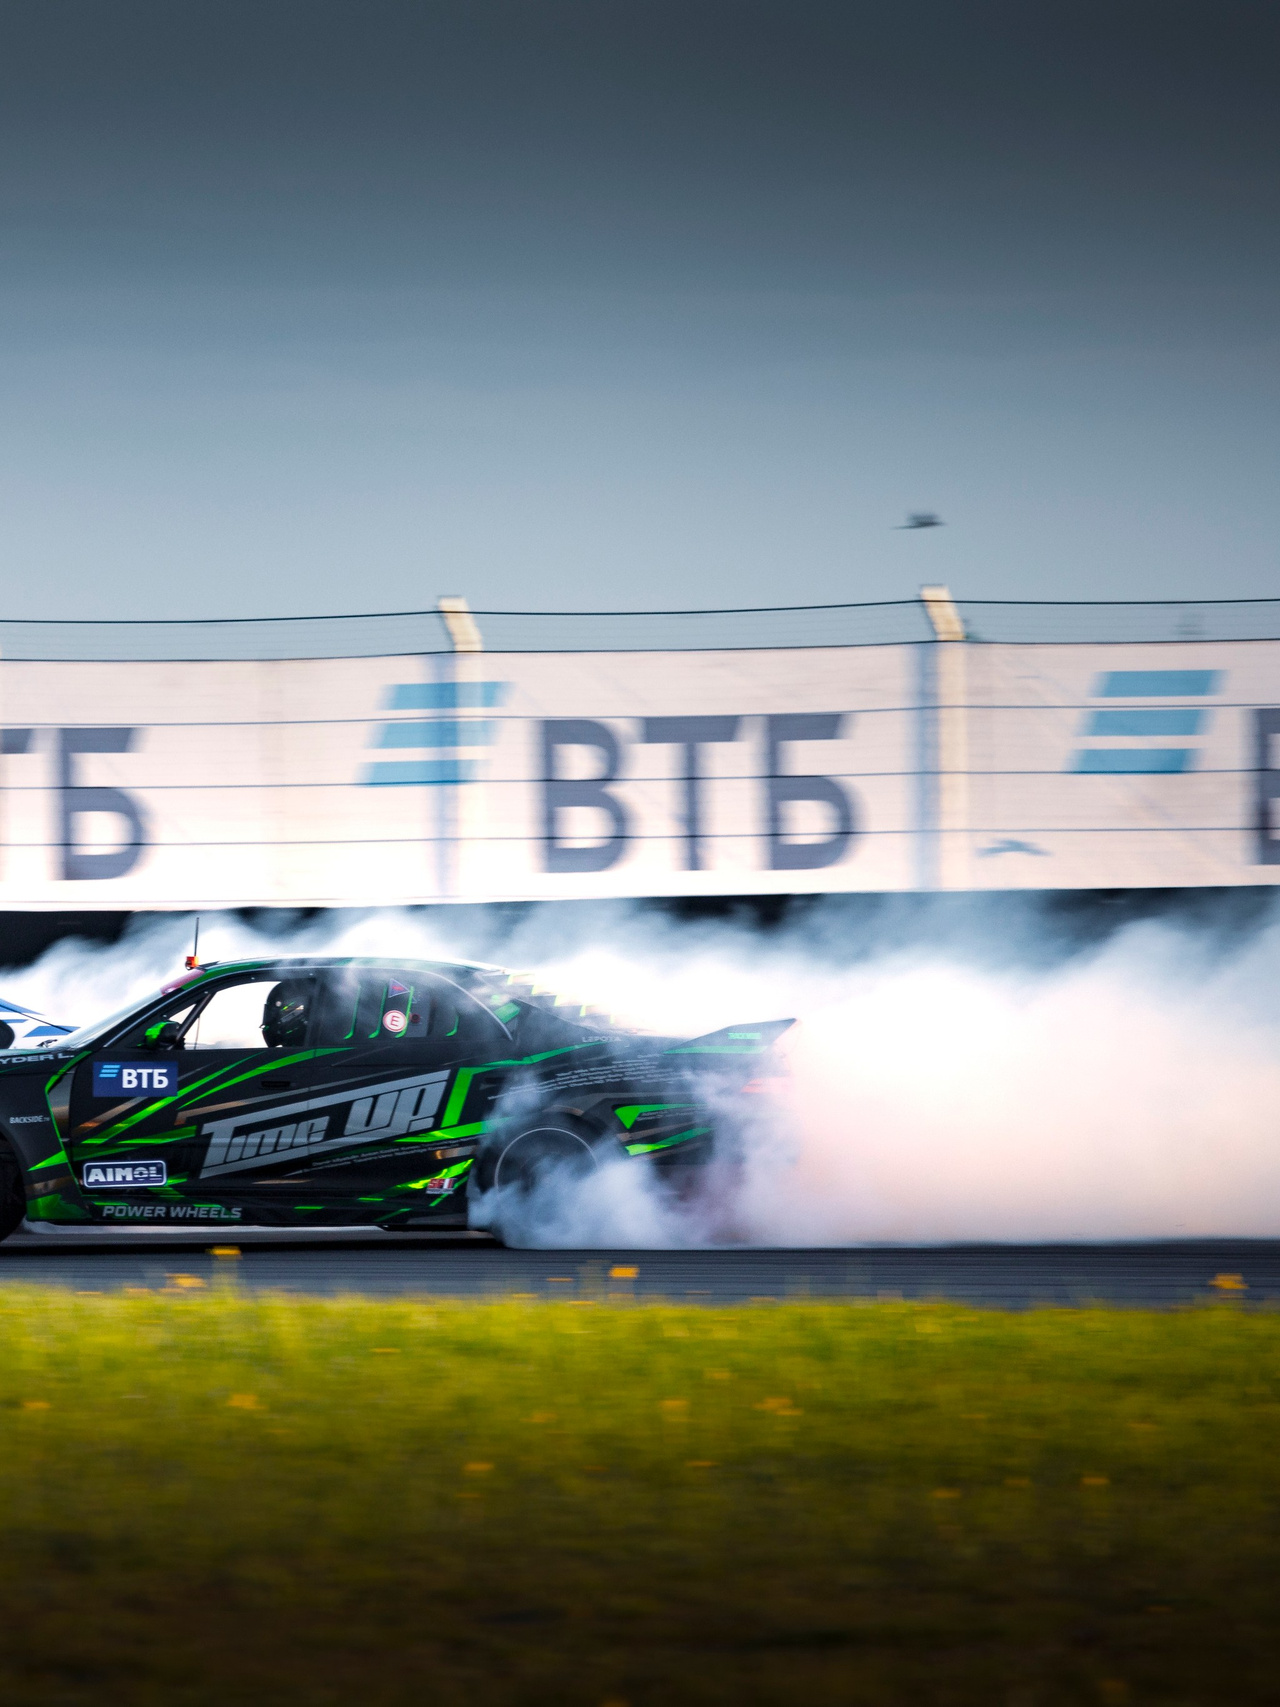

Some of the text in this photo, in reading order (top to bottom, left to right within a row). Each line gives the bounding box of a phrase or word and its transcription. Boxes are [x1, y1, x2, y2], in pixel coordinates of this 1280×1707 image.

[538, 713, 863, 874] ВТБ
[390, 1015, 400, 1027] E
[122, 1068, 169, 1089] ВТБ
[87, 1166, 163, 1183] AIMOL
[102, 1205, 243, 1219] POWER WHEELS
